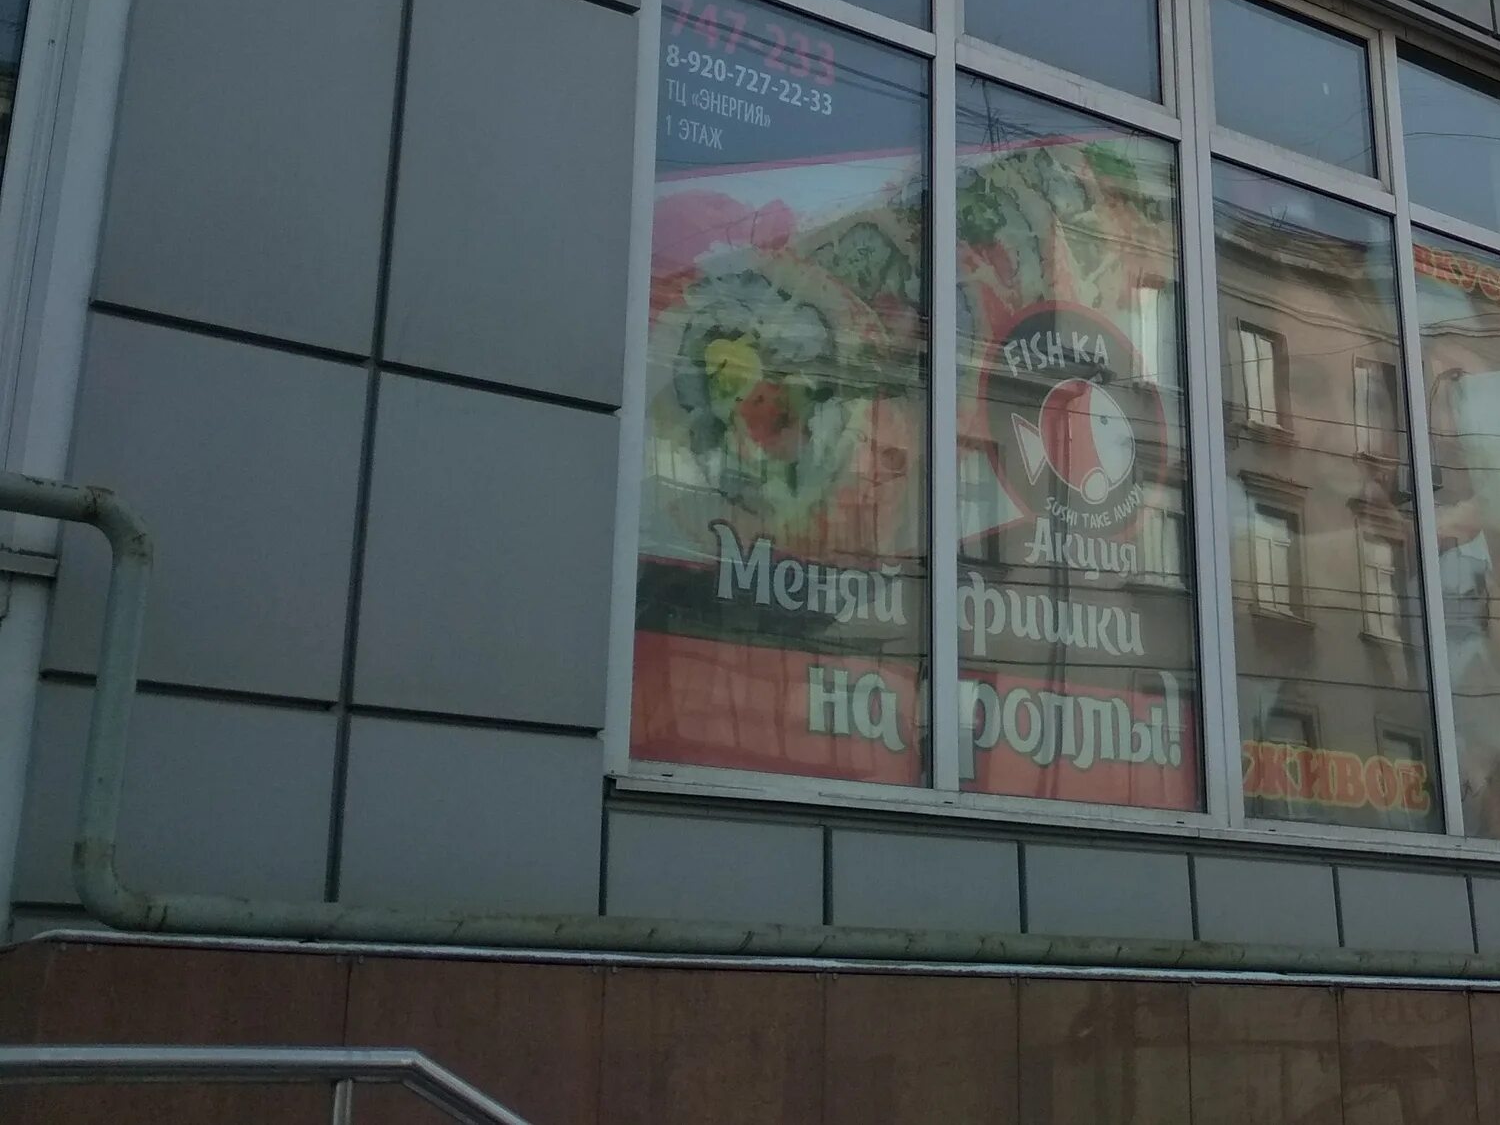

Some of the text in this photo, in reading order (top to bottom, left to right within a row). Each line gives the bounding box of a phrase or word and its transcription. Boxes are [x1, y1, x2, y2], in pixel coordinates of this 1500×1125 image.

[665, 43, 834, 116] 8-920-727-22-33
[665, 78, 772, 128] ТЦ «ЭНЕРГИЯ»
[664, 114, 724, 151] 1 ЭТАЖ
[1044, 495, 1078, 527] SUSHI
[1081, 511, 1113, 530] TAKE
[1024, 516, 1138, 581] Акция
[707, 519, 1146, 659] Меняй фишки
[806, 664, 907, 753] на
[1242, 740, 1431, 815] ЖИВОЕ
